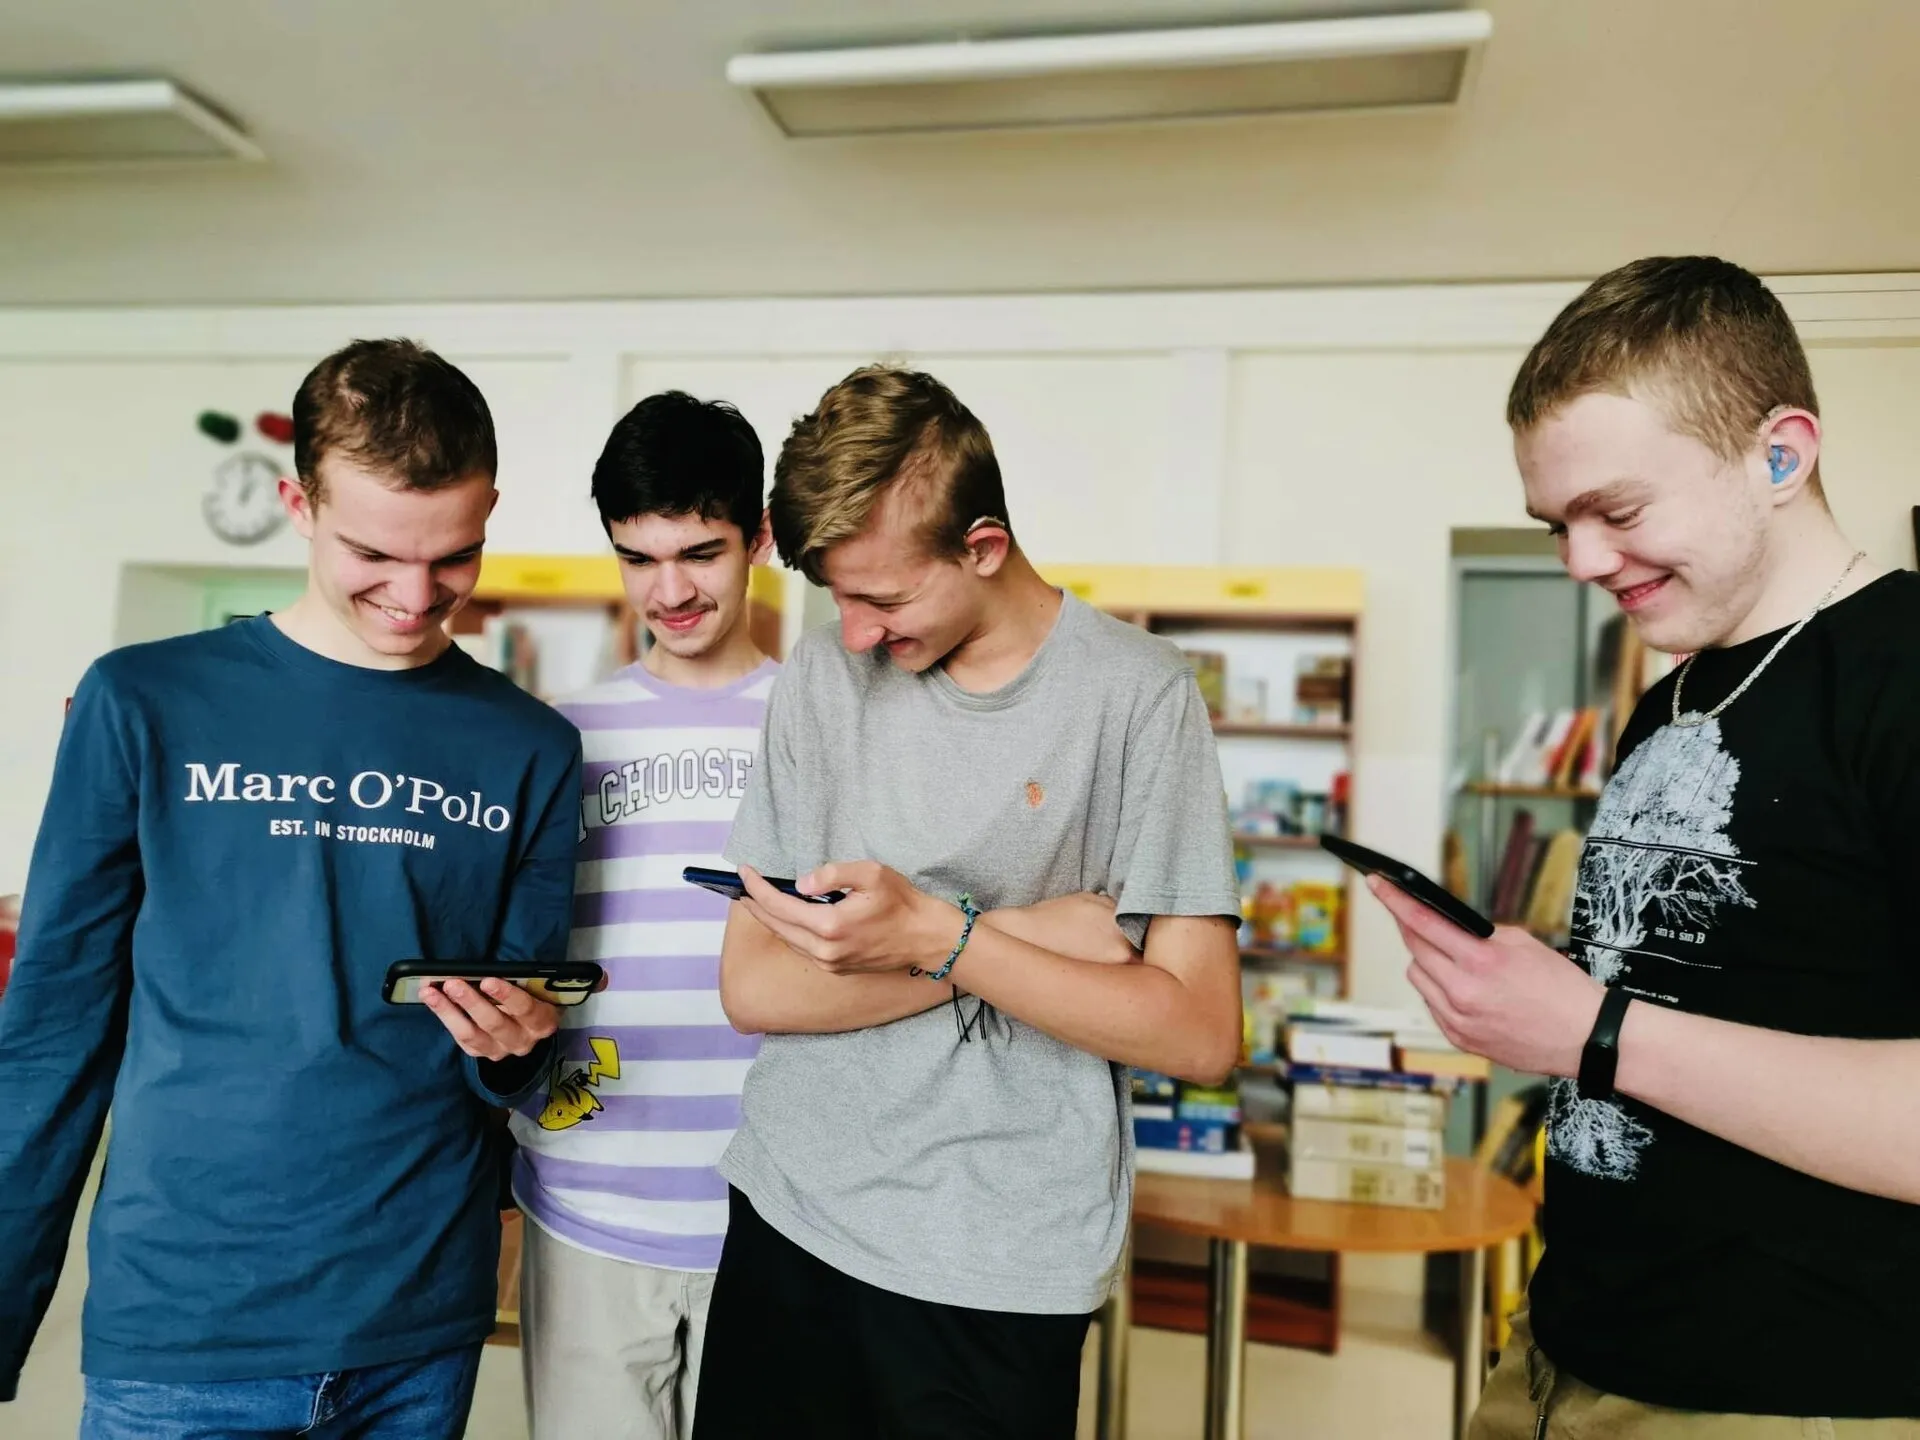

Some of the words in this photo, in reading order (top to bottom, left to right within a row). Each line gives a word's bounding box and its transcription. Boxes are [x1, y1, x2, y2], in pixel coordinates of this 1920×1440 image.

[184, 763, 336, 804] Marc
[349, 770, 511, 833] O’Polo
[599, 747, 753, 826] CHOOSE
[270, 819, 308, 836] EST.
[315, 820, 331, 838] IN
[336, 825, 436, 851] STOCKHOLM
[1694, 931, 1706, 945] B
